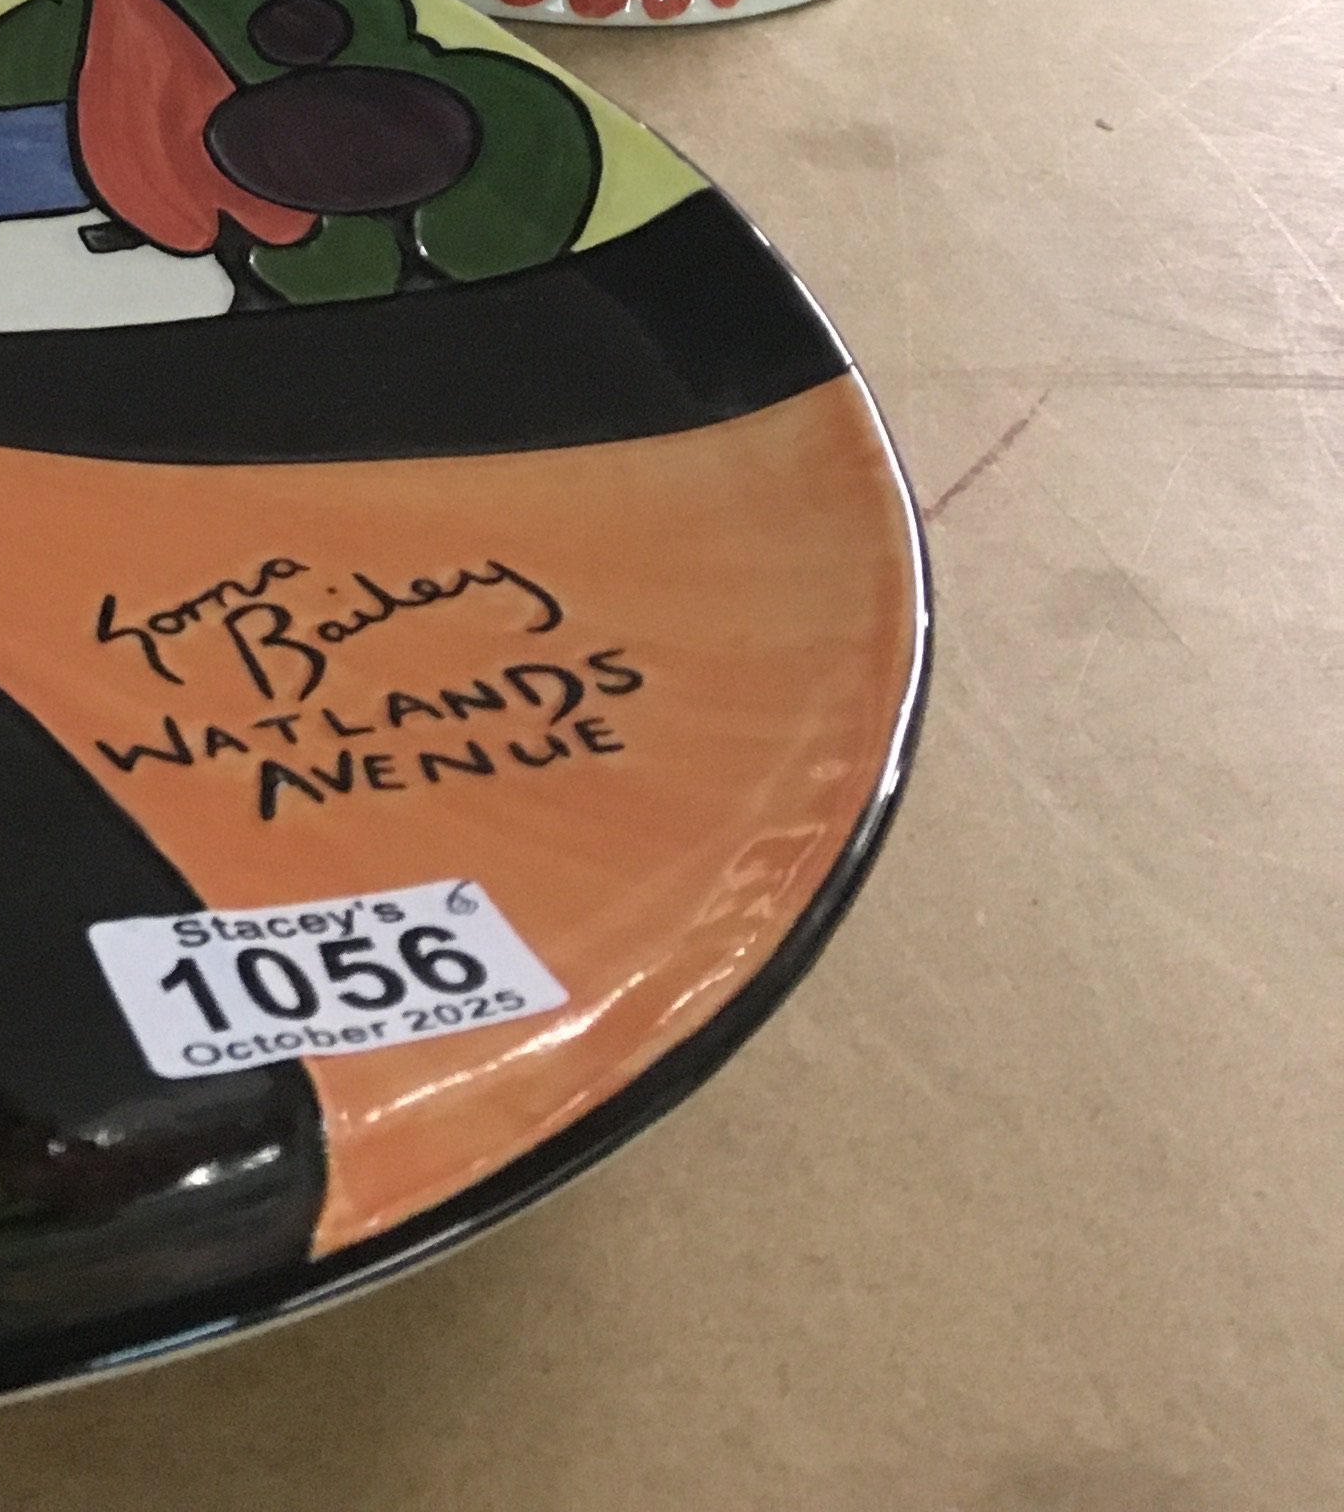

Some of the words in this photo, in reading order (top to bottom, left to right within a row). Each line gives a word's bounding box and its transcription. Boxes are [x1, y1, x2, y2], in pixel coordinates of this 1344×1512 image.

[95, 648, 644, 772] WATLANDS
[258, 717, 625, 821] AVENUE
[172, 900, 406, 948] Stacey's
[160, 925, 488, 1034] 1056
[181, 1018, 388, 1068] October
[401, 988, 528, 1033] 2025
